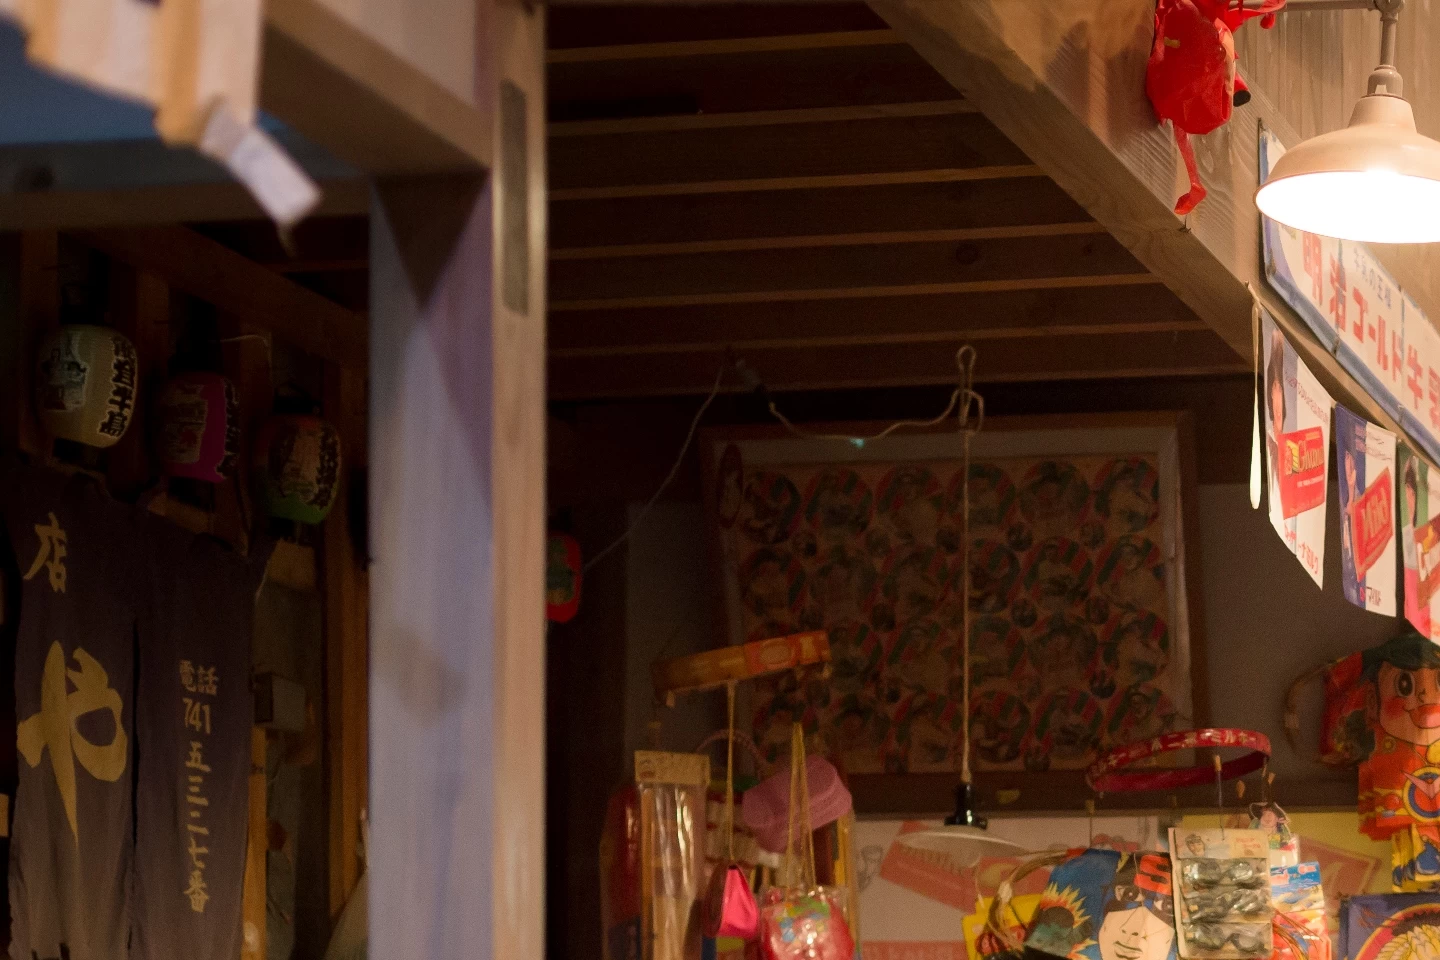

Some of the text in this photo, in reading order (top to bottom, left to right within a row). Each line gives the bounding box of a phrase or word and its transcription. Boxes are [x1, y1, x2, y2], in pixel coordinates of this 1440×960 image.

[23, 512, 68, 594] 店
[16, 639, 128, 849] や
[179, 659, 220, 913] 電話 741 五三二七番
